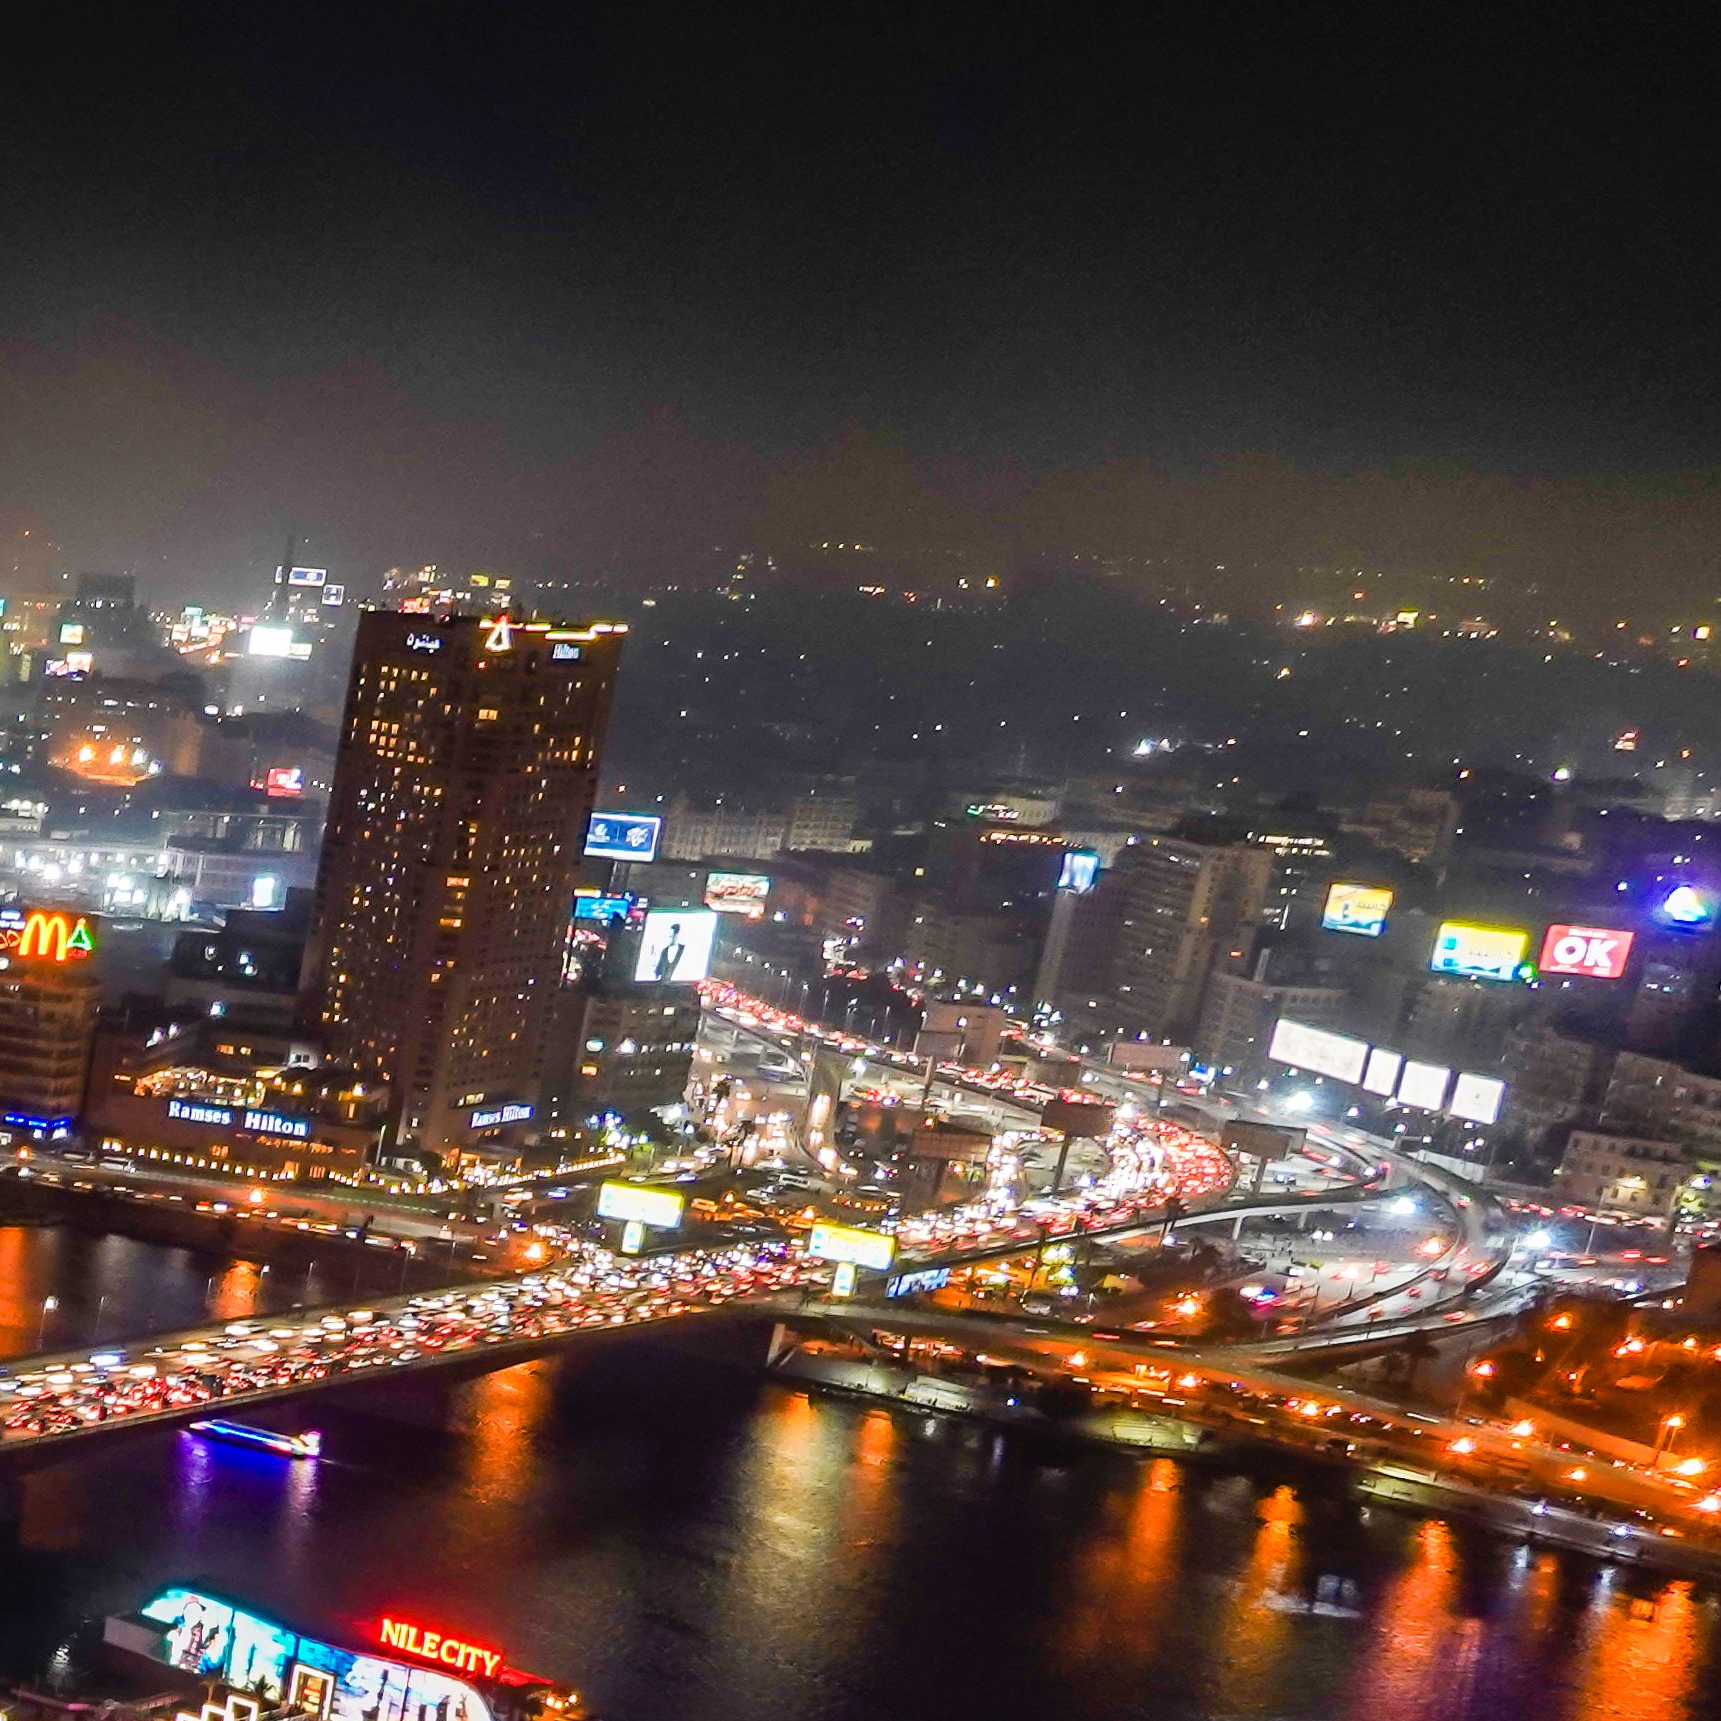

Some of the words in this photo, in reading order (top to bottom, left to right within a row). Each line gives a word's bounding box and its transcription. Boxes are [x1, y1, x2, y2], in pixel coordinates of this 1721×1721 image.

[1553, 936, 1619, 968] OK
[168, 1100, 232, 1125] Ramses
[244, 1110, 308, 1137] Hilton
